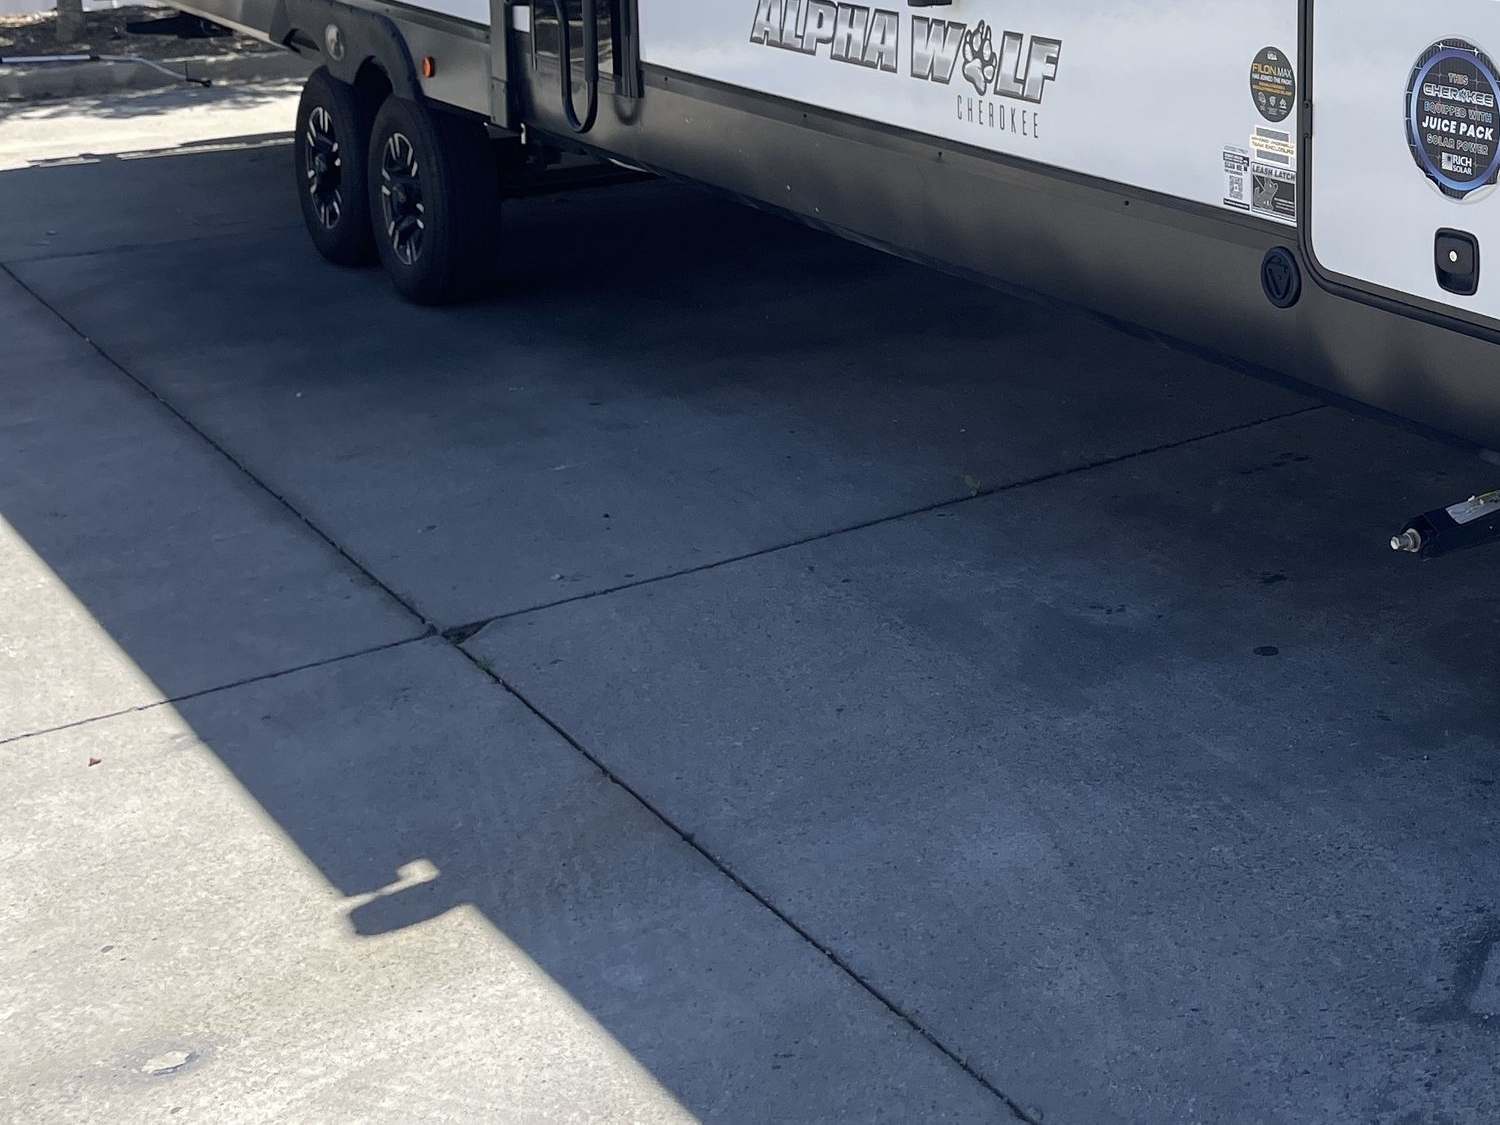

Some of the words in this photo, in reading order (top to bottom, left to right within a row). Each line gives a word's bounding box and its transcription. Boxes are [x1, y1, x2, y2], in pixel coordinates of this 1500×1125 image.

[1448, 73, 1469, 85] THIS
[1423, 83, 1494, 107] CHEROKEE
[957, 94, 1039, 139] CHEROKEE
[1424, 101, 1467, 118] EQUIPPED
[1468, 109, 1492, 123] WITH
[1422, 116, 1457, 133] JUICE
[1460, 123, 1494, 140] PACK
[1427, 134, 1455, 149] SOLAR
[1456, 140, 1488, 155] POWER
[1453, 154, 1472, 167] RICH
[1453, 165, 1472, 175] SOLAR
[1252, 165, 1273, 176] LEASH
[1274, 170, 1295, 181] LATCH
